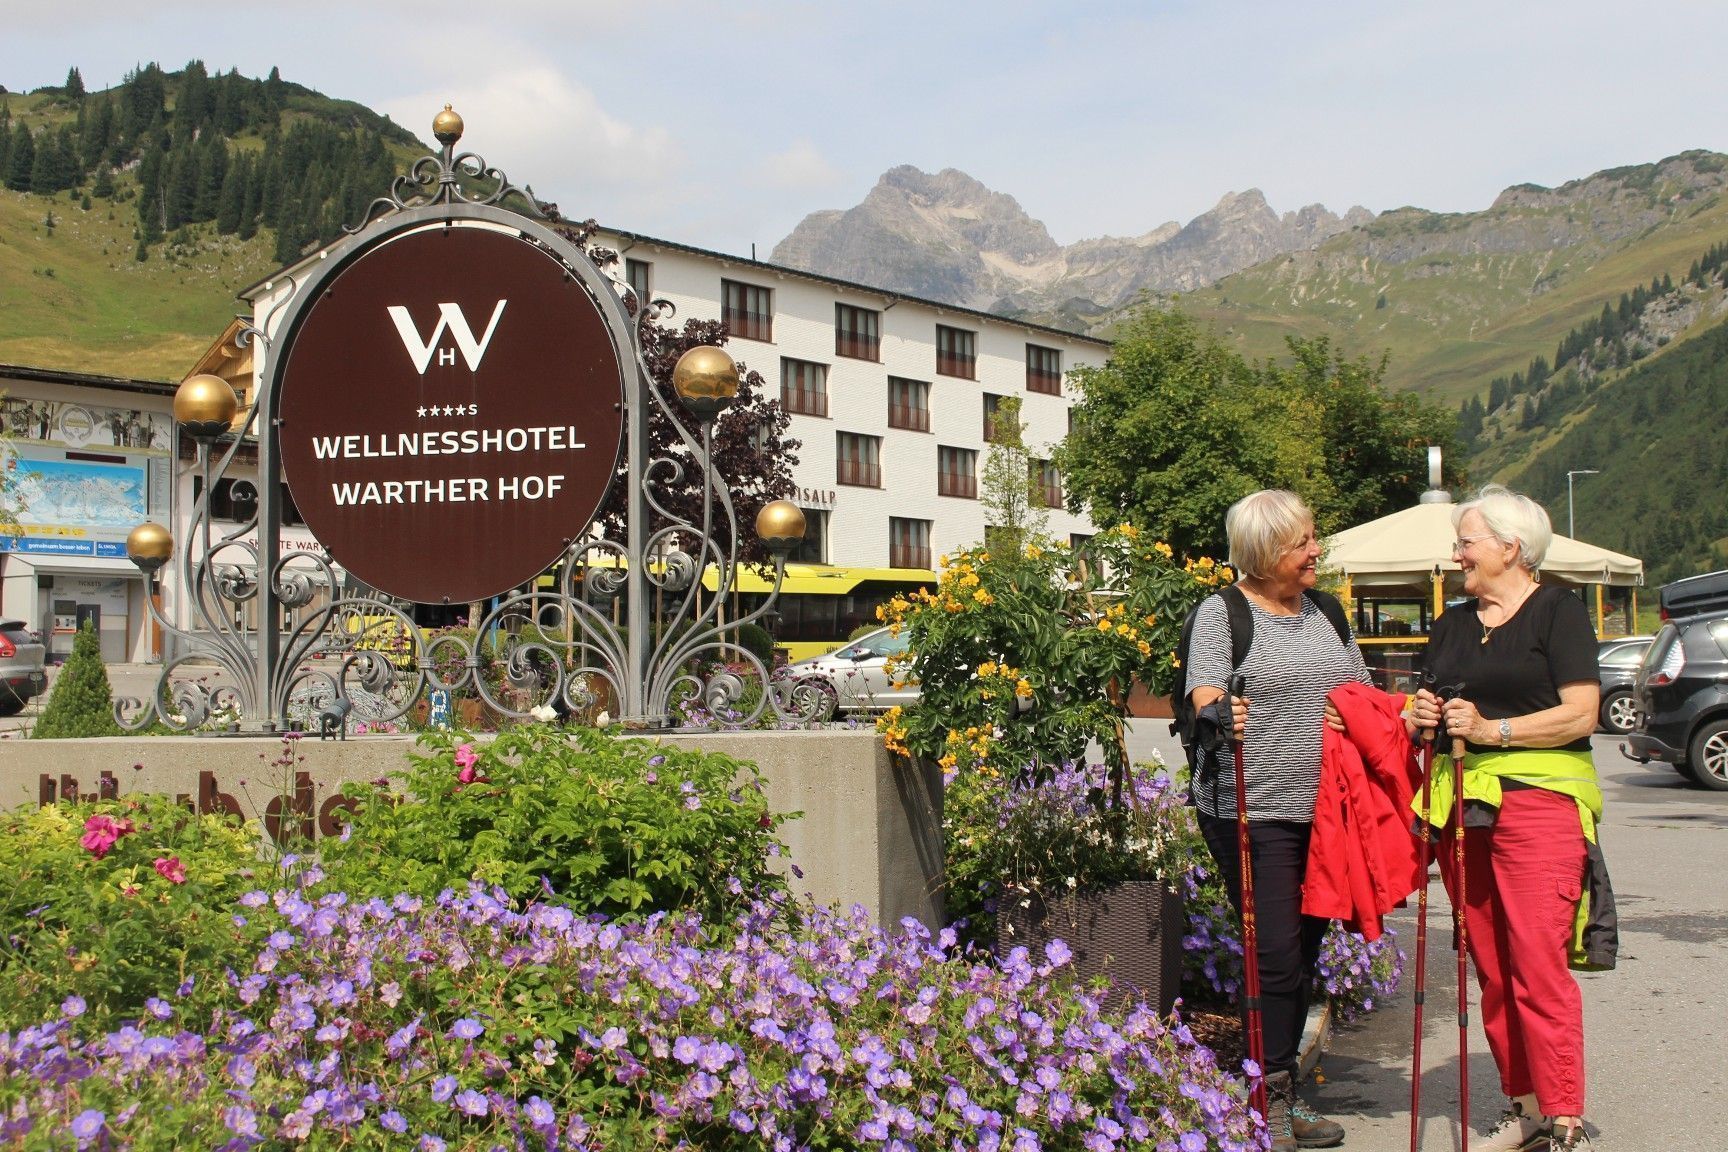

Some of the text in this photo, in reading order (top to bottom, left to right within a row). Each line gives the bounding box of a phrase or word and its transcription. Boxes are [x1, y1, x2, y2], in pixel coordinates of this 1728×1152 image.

[311, 425, 586, 460] WELLNESSHOTEL
[331, 475, 565, 506] WARTHER HOF
[797, 487, 836, 504] ISALP
[295, 541, 324, 552] WAR
